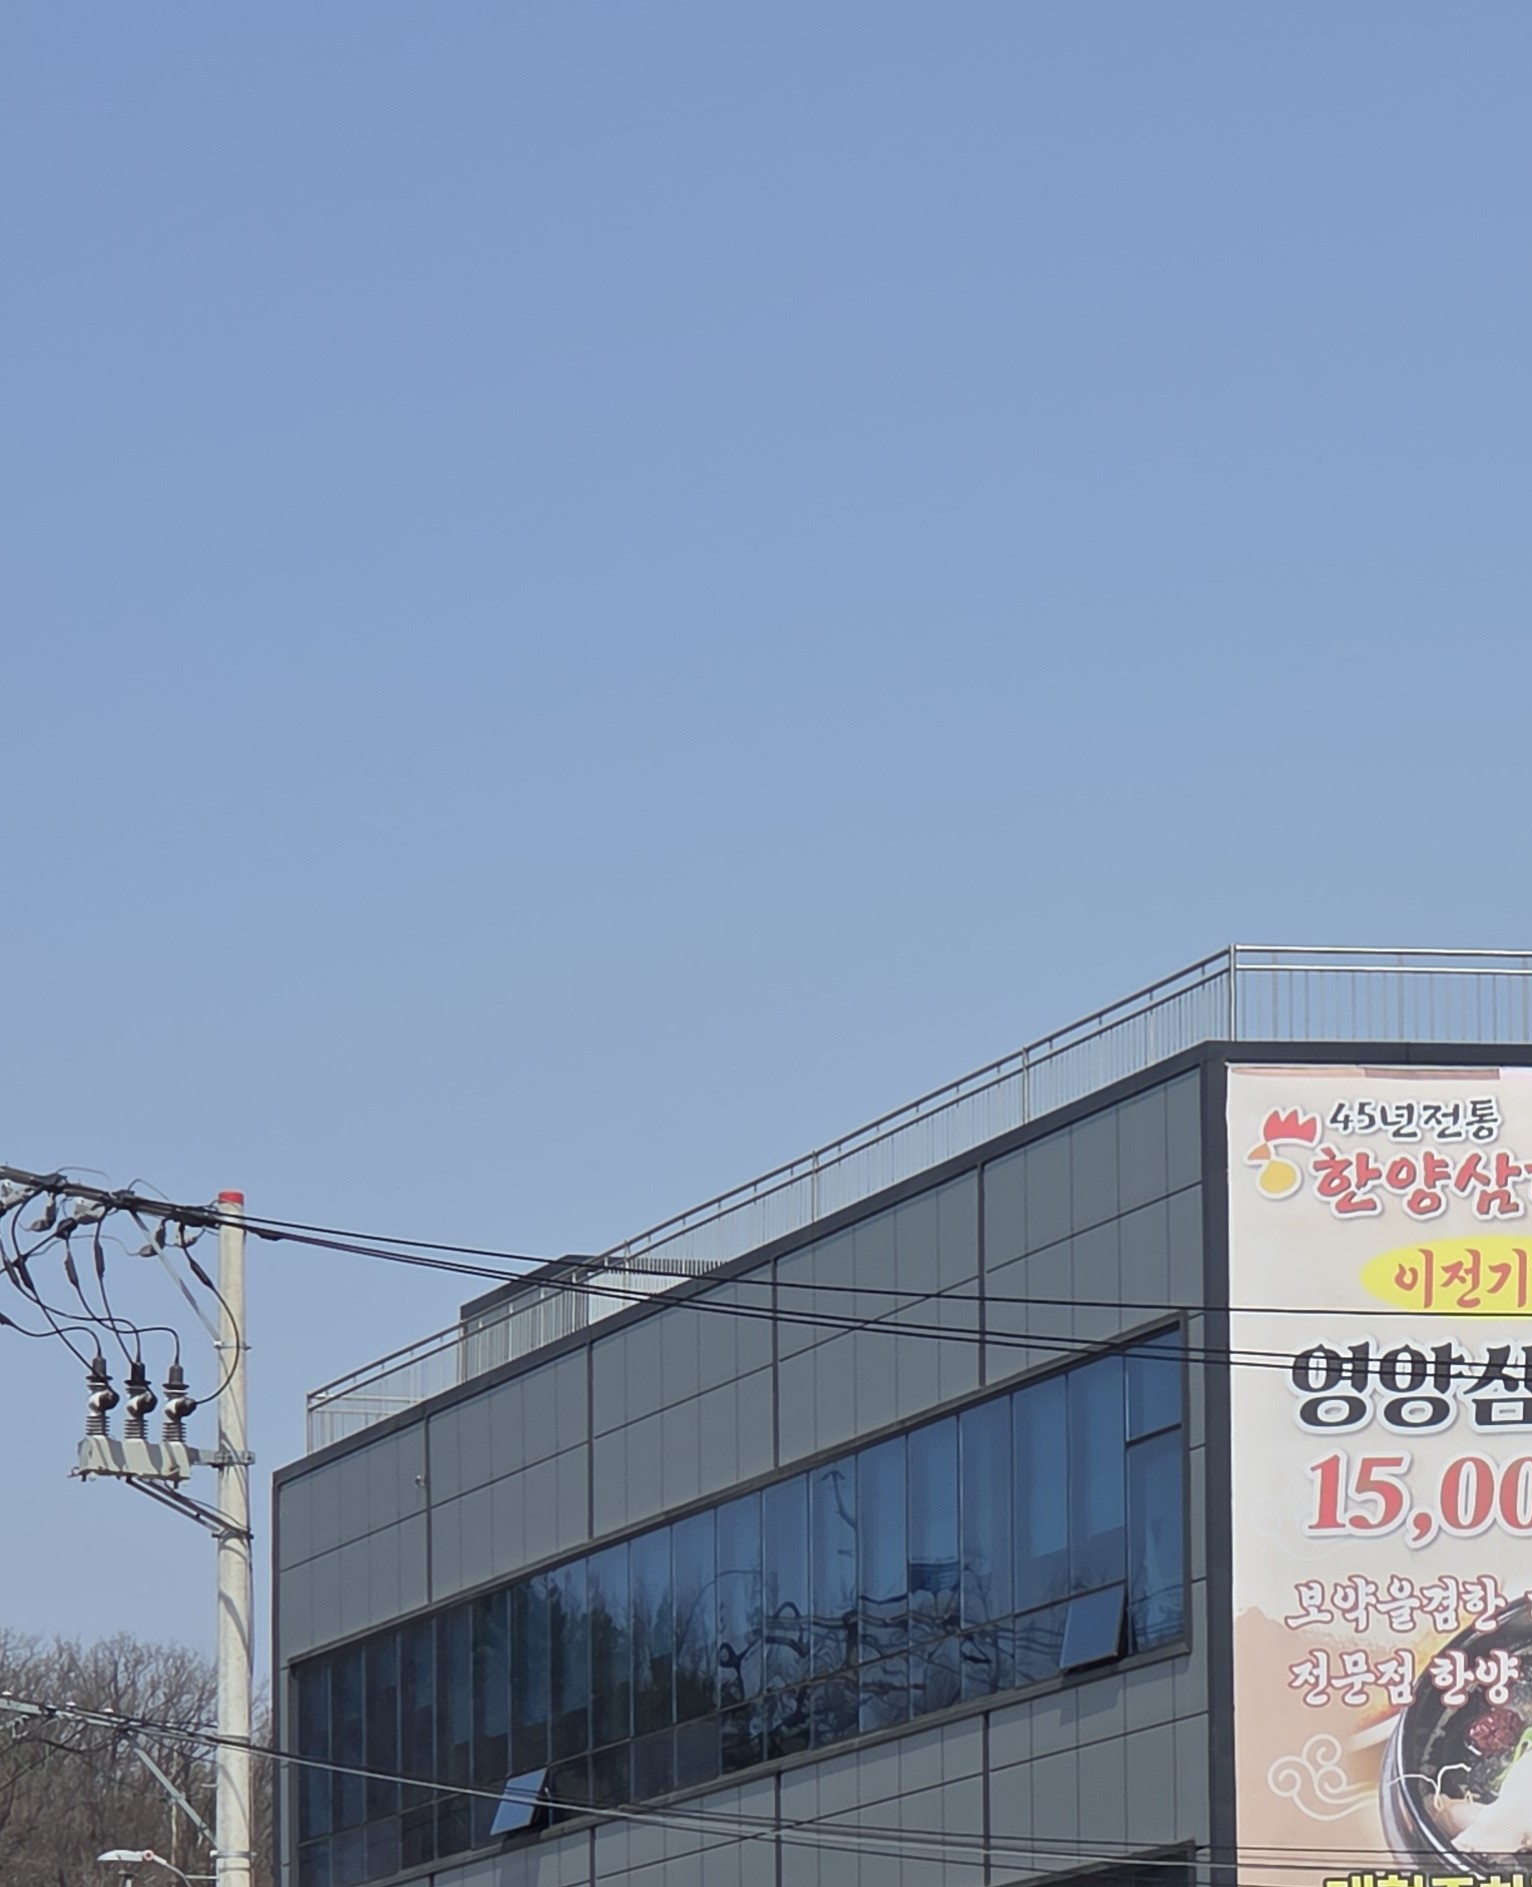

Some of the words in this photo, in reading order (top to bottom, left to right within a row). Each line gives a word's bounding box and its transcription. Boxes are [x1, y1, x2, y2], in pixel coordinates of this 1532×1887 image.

[1329, 1099, 1499, 1139] 45년전통
[1289, 1651, 1415, 1704] 전문점
[1430, 1650, 1519, 1704] 한양
